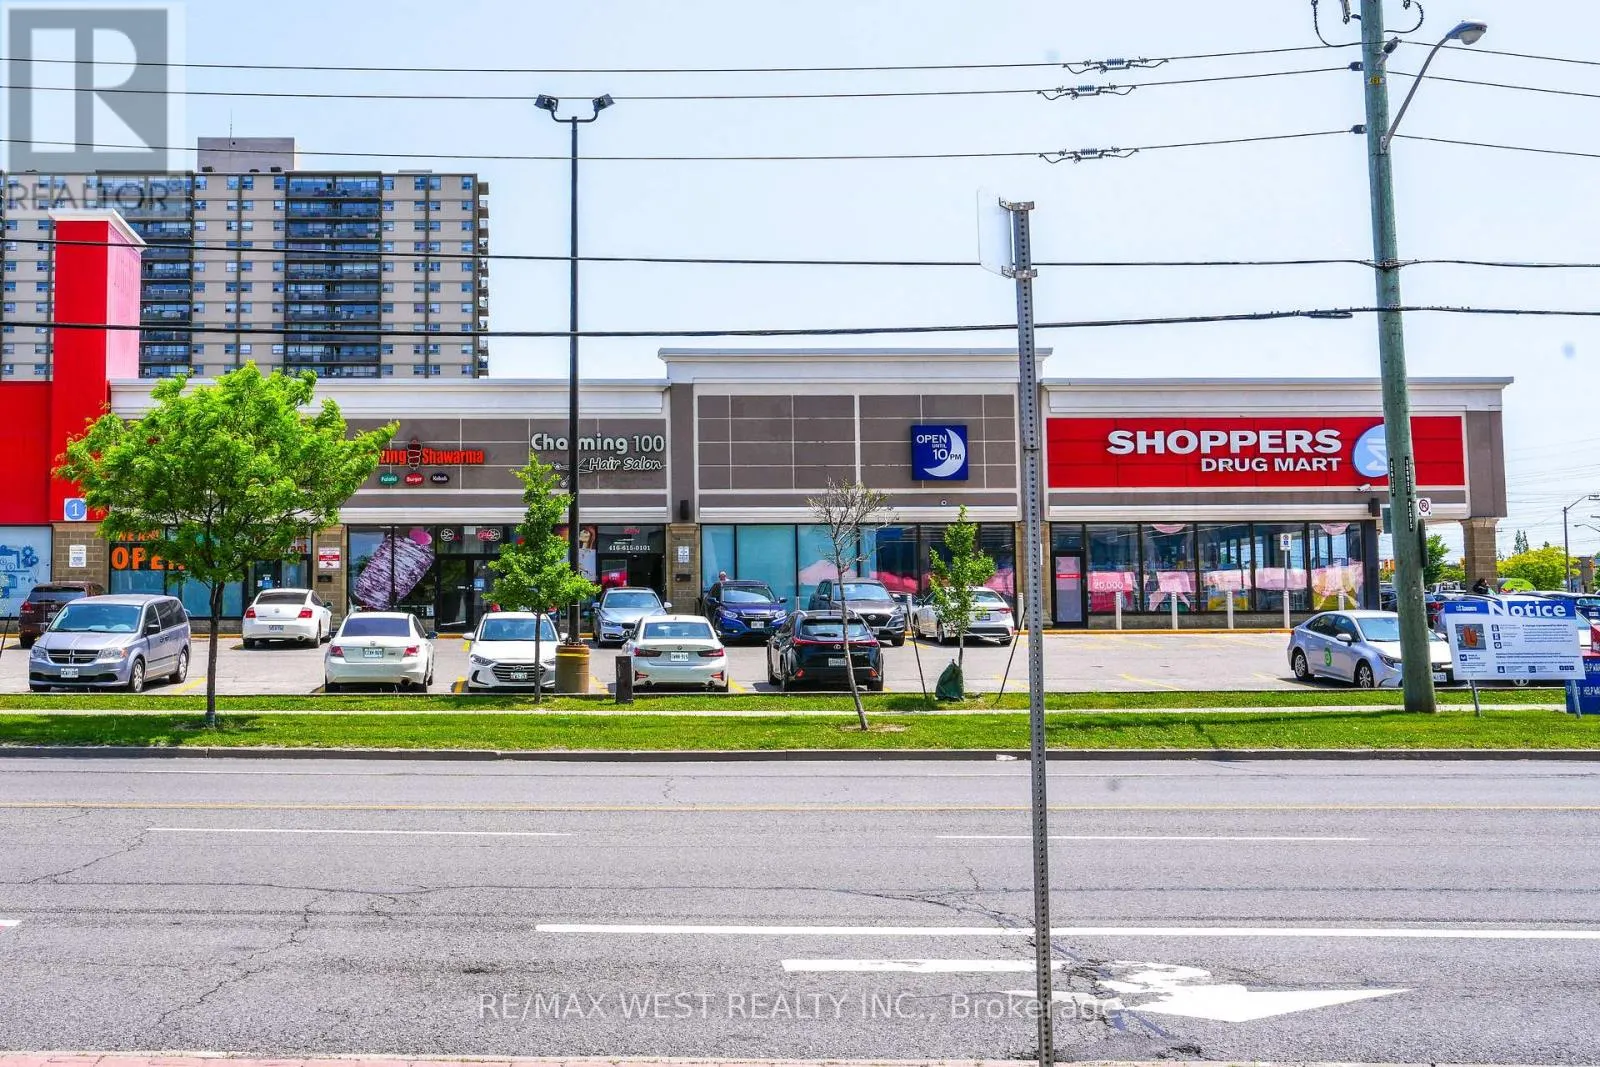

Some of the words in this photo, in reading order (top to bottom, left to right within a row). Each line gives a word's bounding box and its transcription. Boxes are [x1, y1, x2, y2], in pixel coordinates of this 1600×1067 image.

[530, 433, 628, 455] Chaming
[633, 435, 665, 452] 100
[916, 434, 947, 444] OPEN
[1106, 429, 1342, 455] SHOPPERS
[422, 448, 484, 464] Shawarma
[933, 448, 949, 461] 10
[589, 456, 621, 471] Hair
[623, 456, 662, 471] Salon
[1201, 457, 1268, 473] DRUG
[1274, 457, 1342, 472] MART
[71, 502, 80, 517] 1
[111, 546, 185, 570] OPE
[1487, 600, 1566, 617] Notice
